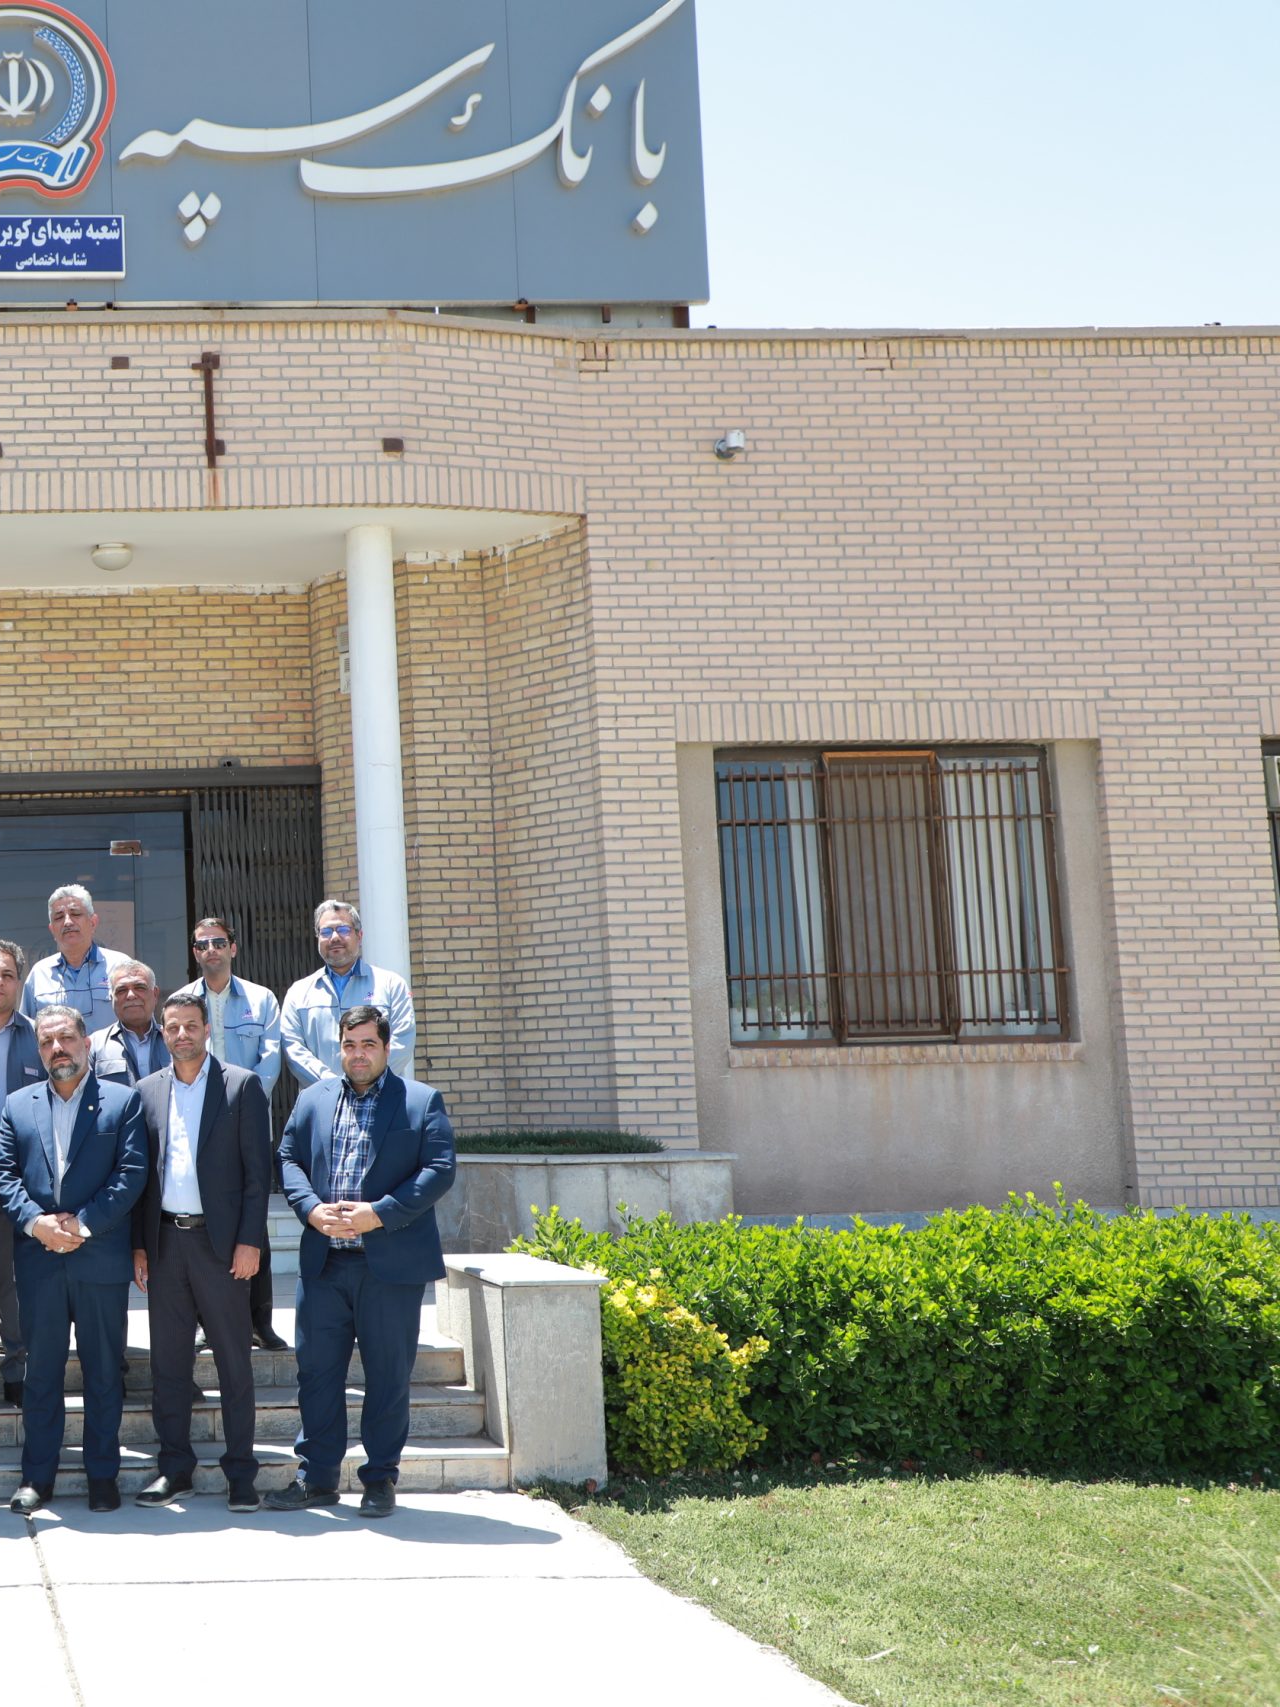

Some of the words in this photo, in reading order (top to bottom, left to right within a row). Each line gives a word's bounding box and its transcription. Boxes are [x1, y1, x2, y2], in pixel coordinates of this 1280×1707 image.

[300, 0, 690, 233] بانک
[120, 43, 495, 248] سپه
[31, 218, 83, 247] شهدای
[86, 218, 120, 246] شعبه
[16, 252, 59, 270] اختصاصی
[61, 252, 88, 266] شناسه
